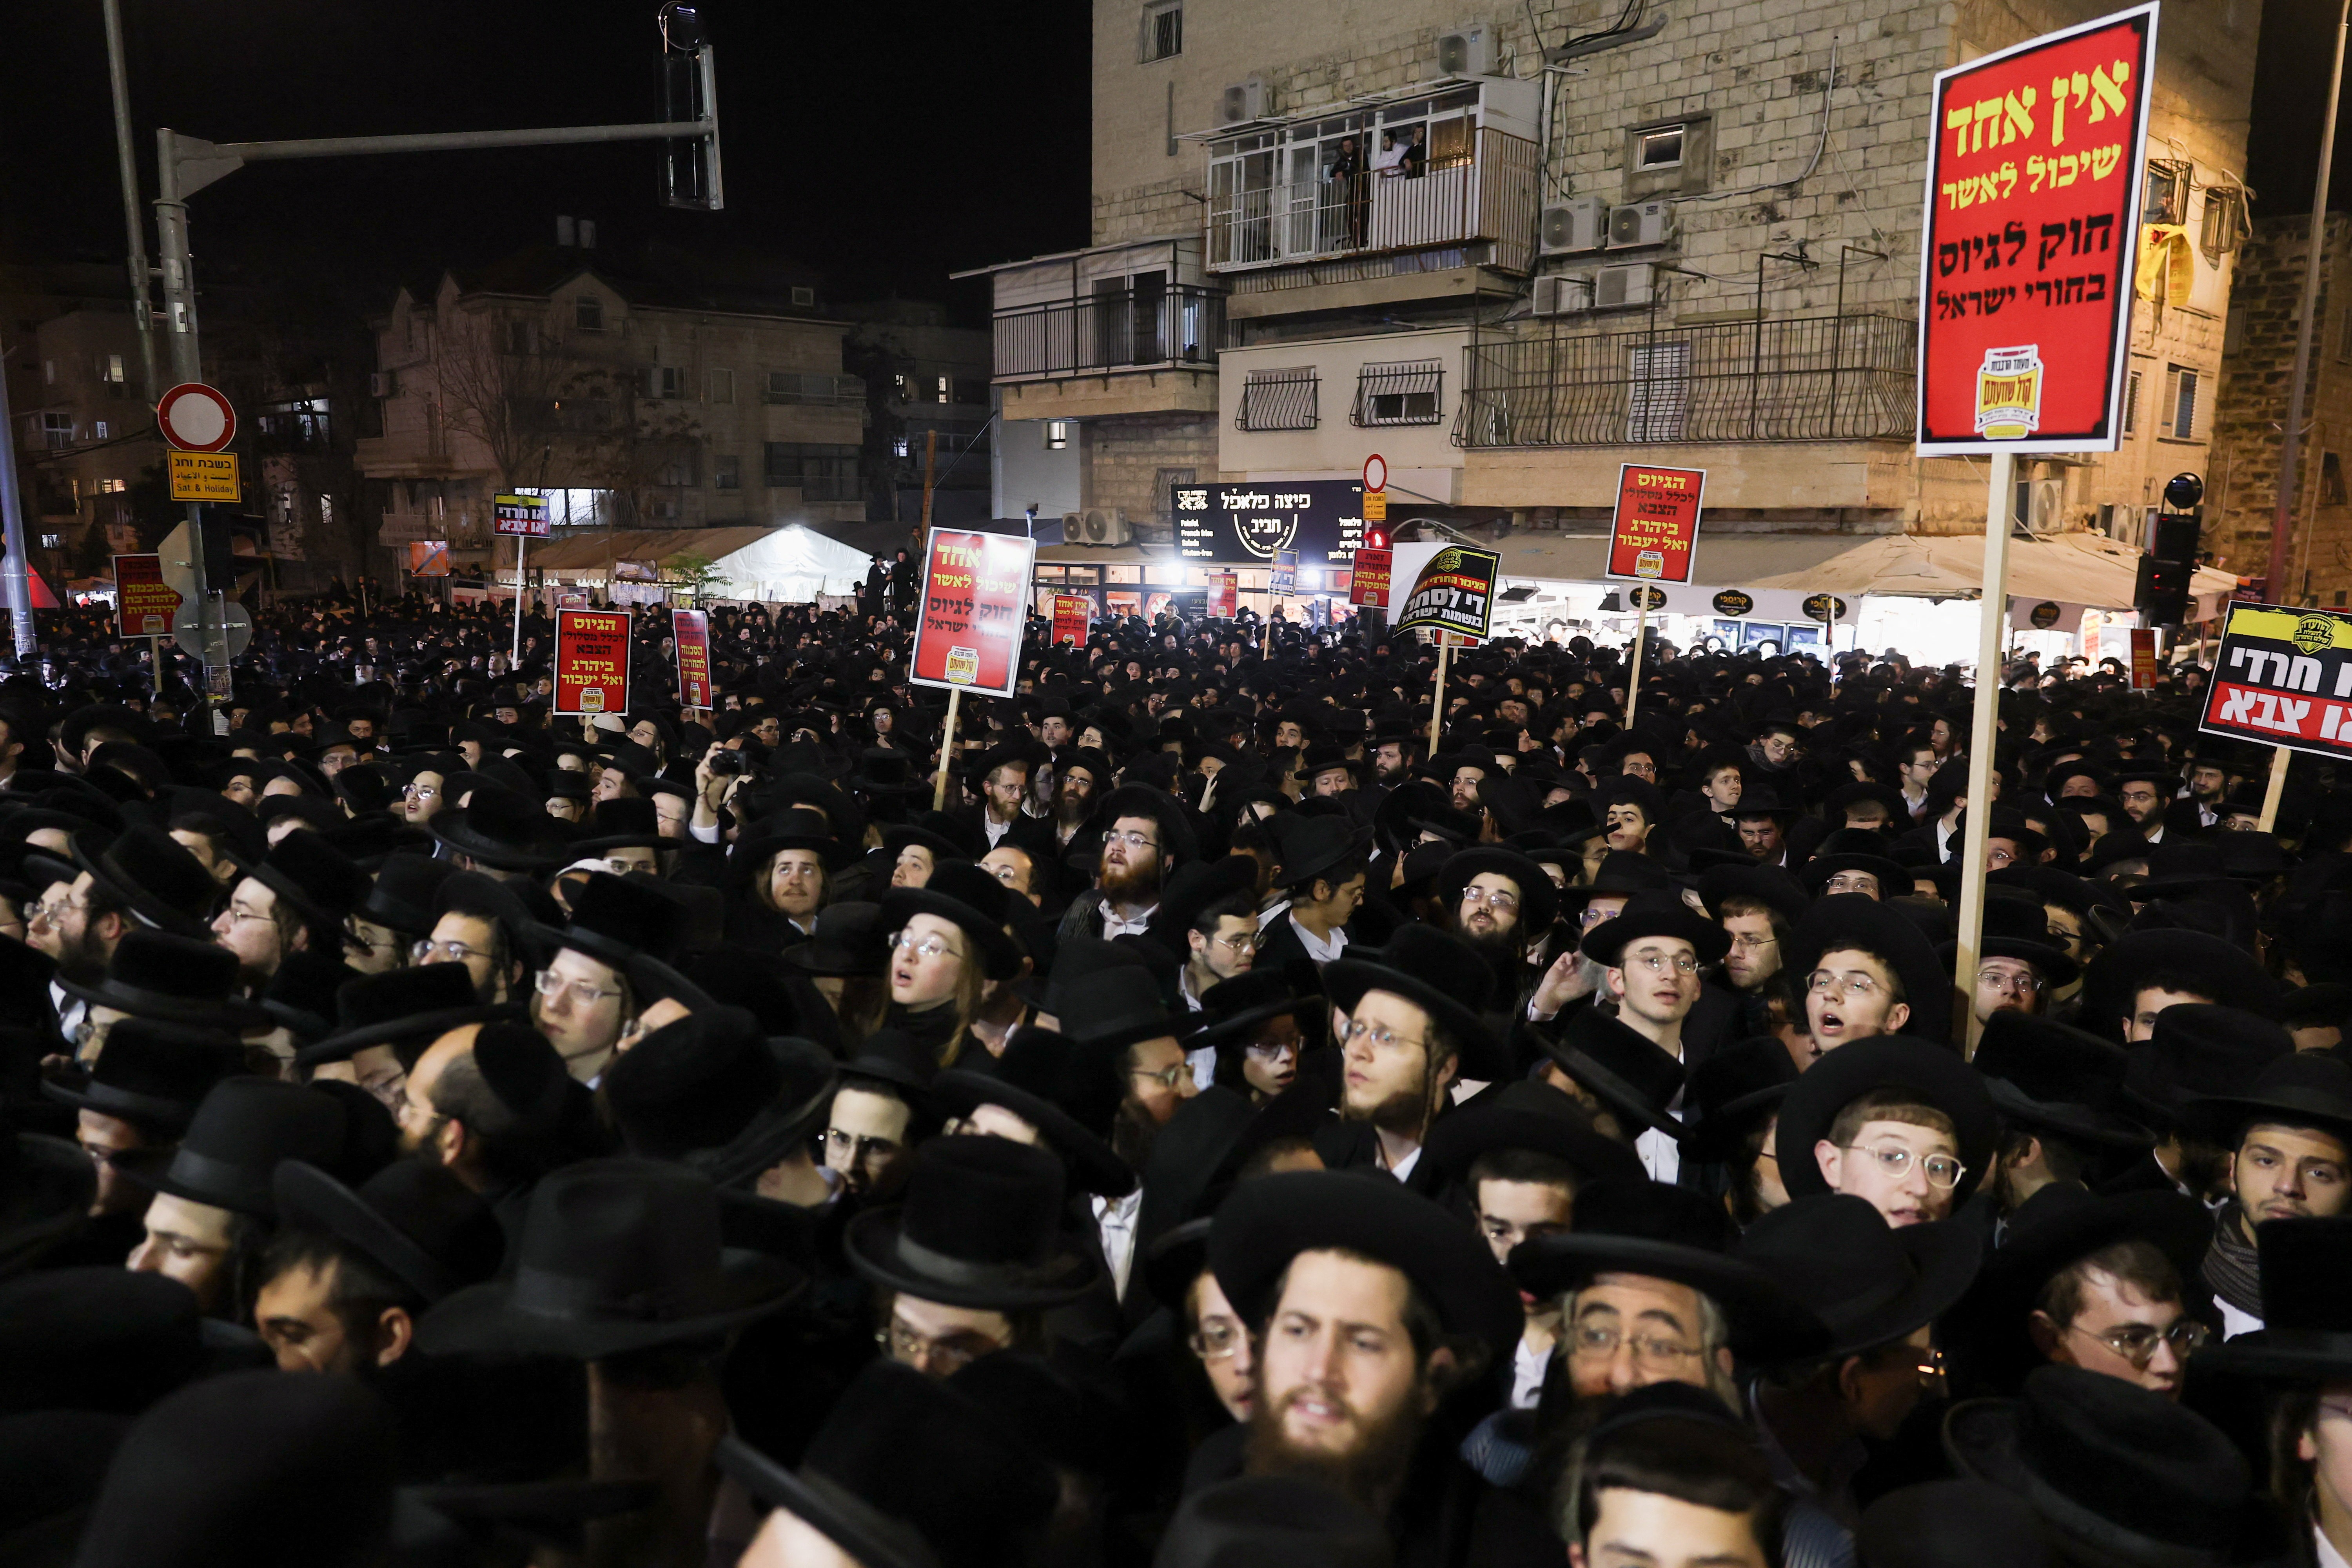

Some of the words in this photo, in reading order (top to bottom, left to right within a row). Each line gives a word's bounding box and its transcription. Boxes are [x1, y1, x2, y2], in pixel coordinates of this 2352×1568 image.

[2051, 59, 2130, 147] אין
[1947, 85, 2036, 157] אחד
[2026, 143, 2122, 193] שיכול
[1943, 162, 2018, 210] לאשר
[1939, 221, 2026, 277] לגיוס
[2038, 213, 2114, 272] חוק
[2025, 273, 2105, 307] בחורי
[1937, 286, 2016, 320] ישראל
[198, 460, 232, 469] בשבת
[1638, 473, 1686, 490] הגיוס
[205, 485, 233, 495] Holiday
[1625, 486, 1662, 500] מסלולי
[1221, 491, 1270, 509] פלאפל
[1274, 494, 1311, 509] פיצה
[1666, 491, 1695, 503] לכלל
[498, 507, 528, 519] חרדי
[532, 509, 546, 520] או
[1637, 502, 1678, 516] הצבא
[500, 520, 528, 532] צבא
[531, 522, 545, 533] או
[1250, 518, 1281, 533] חביב
[1339, 517, 1362, 526] פלאפל
[1630, 519, 1679, 535] ביהרג
[1339, 539, 1362, 548] סלטים
[1618, 534, 1658, 548] יעבור
[1662, 536, 1688, 551] ואל
[937, 544, 982, 568] אחד
[1328, 550, 1347, 560] גלוטן
[1358, 562, 1390, 571] התורה
[933, 572, 972, 588] לאשר
[1284, 573, 1294, 584] די
[1355, 571, 1375, 579] תהא
[1378, 572, 1390, 581] לא
[1430, 575, 1457, 584] החרדי
[976, 575, 1016, 594] שיכול
[1354, 580, 1390, 590] מופקרת
[1459, 578, 1486, 591] הציבור
[125, 593, 176, 604] להחרבת
[1407, 587, 1461, 612] לסחר
[1465, 593, 1485, 615] די
[1720, 596, 1747, 606] קריספי
[127, 605, 176, 614] היהדות
[930, 597, 974, 615] לגיוס
[979, 603, 1013, 621] חוק
[1075, 601, 1087, 610] אין
[573, 617, 616, 631] הגיוס
[927, 616, 968, 632] ישראל
[1441, 608, 1483, 628] בנשמות
[563, 631, 597, 641] מסלולי
[601, 633, 625, 642] לכלל
[576, 644, 612, 655] הצבא
[681, 644, 702, 656] הסכמה
[572, 659, 614, 671] ביהרג
[681, 657, 705, 669] להחרבת
[683, 670, 705, 682] היהדות
[2229, 647, 2323, 693] חרדי
[561, 674, 598, 685] יעבור
[602, 673, 623, 685] ואל
[2220, 688, 2311, 734] צבא
